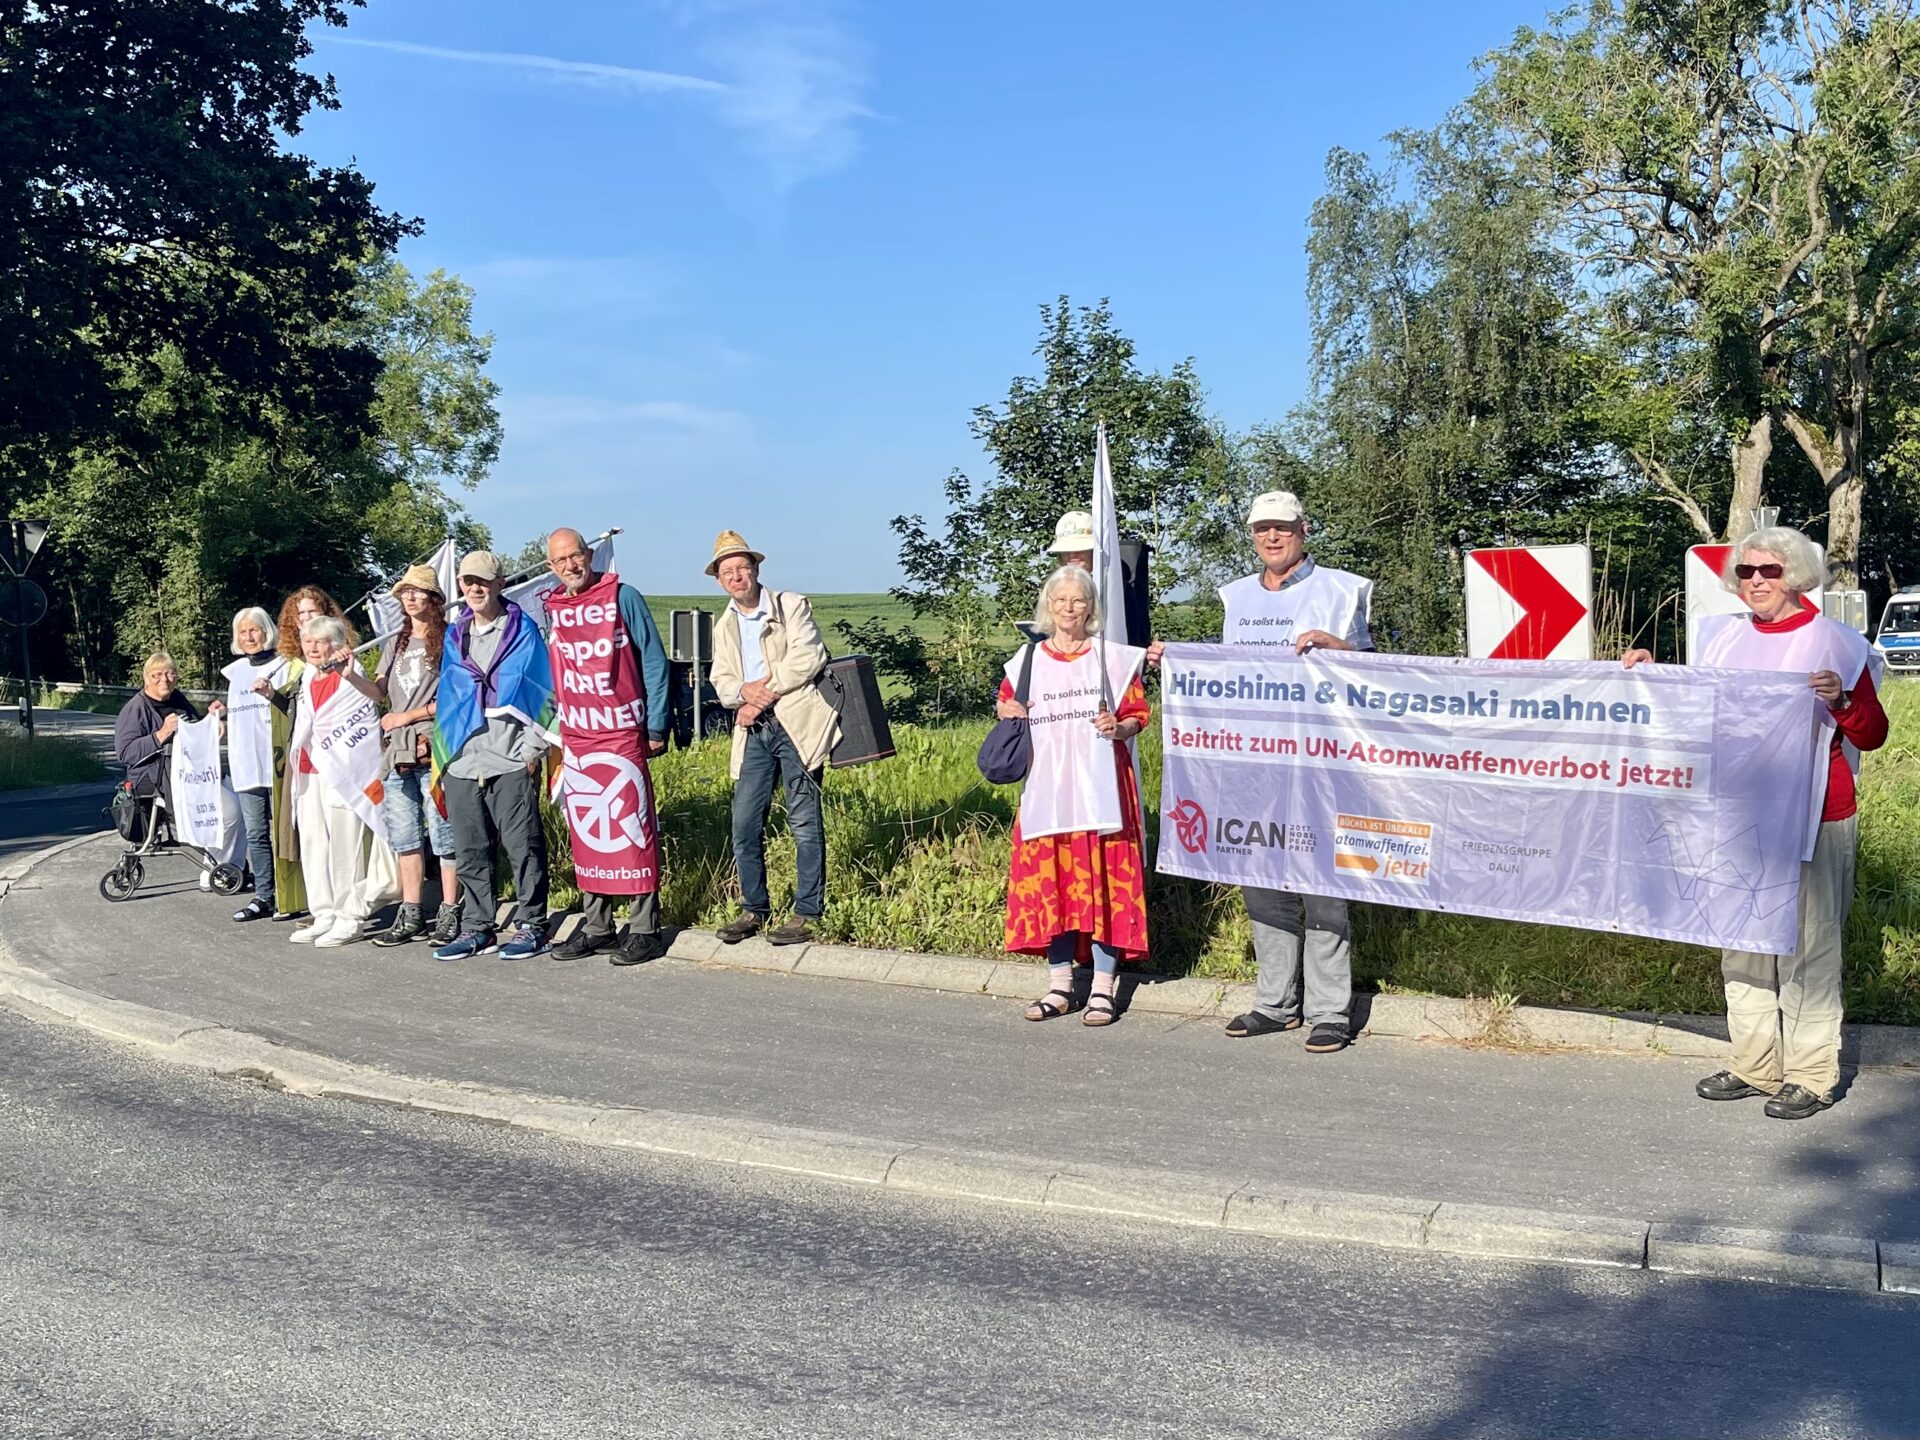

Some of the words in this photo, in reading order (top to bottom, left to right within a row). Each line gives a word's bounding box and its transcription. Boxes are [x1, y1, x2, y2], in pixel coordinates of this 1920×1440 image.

[1239, 617, 1250, 626] Du
[1252, 617, 1274, 626] sollst
[1275, 616, 1294, 626] kein
[563, 669, 615, 697] ARE
[1043, 693, 1056, 702] Du
[1058, 689, 1082, 699] sollst
[1169, 670, 1306, 703] Hiroshima
[1314, 681, 1337, 704] &
[1347, 683, 1499, 718] Nagasaki
[1509, 694, 1651, 725] mahnen
[556, 698, 645, 730] ANNED
[1029, 709, 1099, 726] tombomben-
[321, 703, 372, 750] 07.07.2017
[344, 727, 369, 748] UNO
[1171, 727, 1243, 752] Beitritt
[1249, 736, 1298, 755] zum
[1305, 737, 1610, 780] UN-Atomwaffenverbot
[1616, 757, 1693, 789] jetzt!
[1216, 817, 1286, 850] ICAN
[1339, 817, 1367, 829] BÜCHEL
[1370, 821, 1384, 831] IST
[1289, 831, 1318, 840] NOBEL
[1289, 838, 1317, 847] PEACE
[1335, 834, 1429, 856] atomwaffenfrei.
[1216, 845, 1253, 856] PARTNER
[1288, 844, 1316, 853] PRIZE
[1462, 840, 1552, 859] FRIEDENSGRUPPE
[1383, 855, 1428, 879] jetzt
[1489, 862, 1520, 874] DAUN
